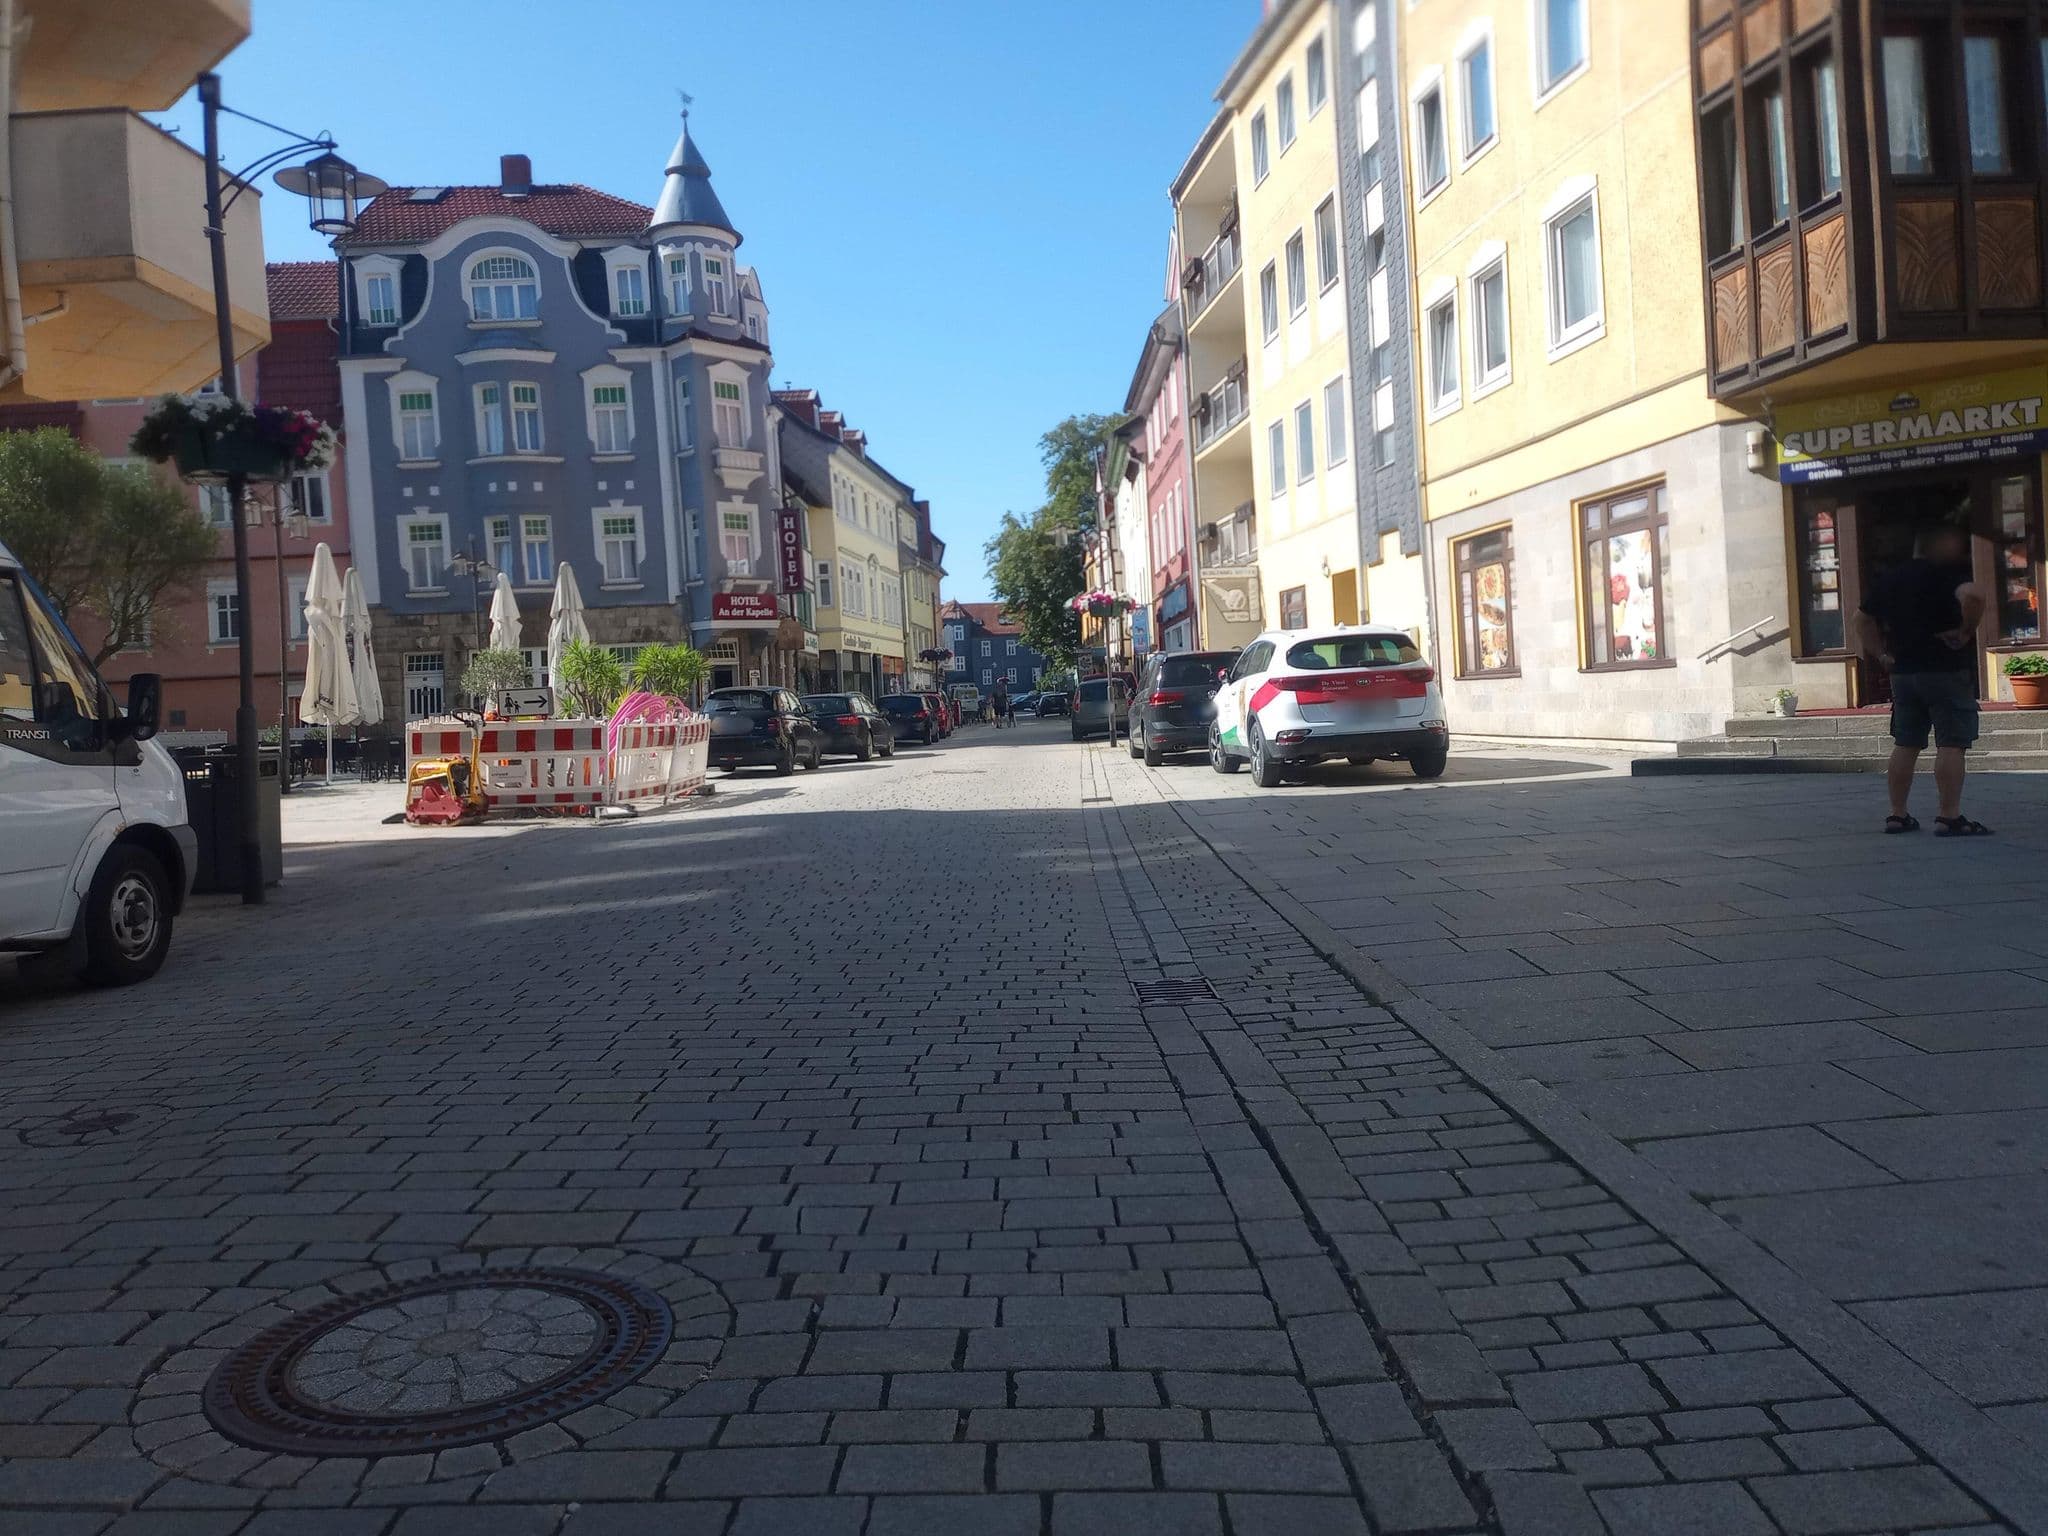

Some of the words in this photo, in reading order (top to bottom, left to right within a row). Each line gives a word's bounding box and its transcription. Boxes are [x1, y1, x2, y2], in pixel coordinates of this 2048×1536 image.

[1783, 397, 2042, 457] SUPERMARKT
[783, 517, 798, 587] HOTEL
[730, 596, 761, 606] HOTEL
[718, 608, 730, 616] An
[731, 607, 744, 616] der
[745, 608, 774, 618] Kapelle
[6, 729, 50, 740] TRANSIT
